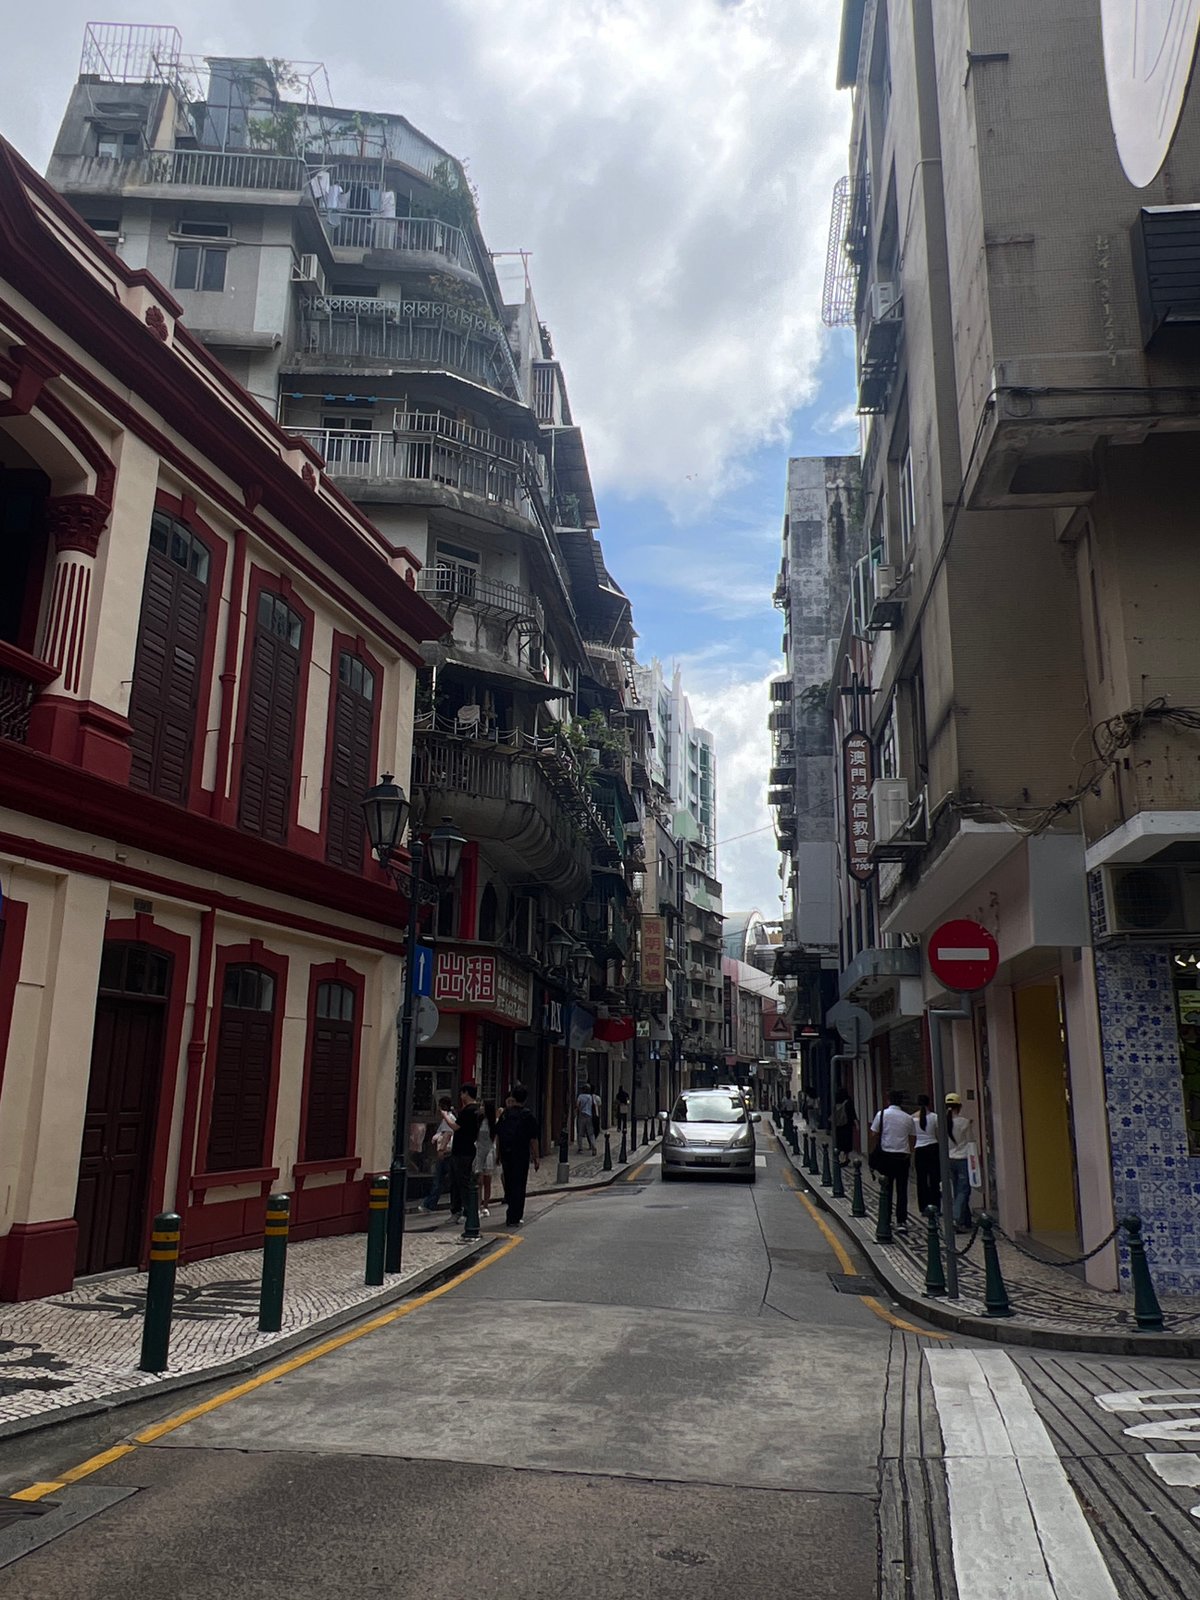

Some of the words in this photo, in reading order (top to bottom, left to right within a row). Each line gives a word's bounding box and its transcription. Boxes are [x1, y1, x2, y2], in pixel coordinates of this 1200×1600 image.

[848, 740, 867, 748] MBC
[850, 750, 869, 854] 澳門浸信教會
[856, 863, 874, 871] 1904
[435, 951, 496, 1003] 出租
